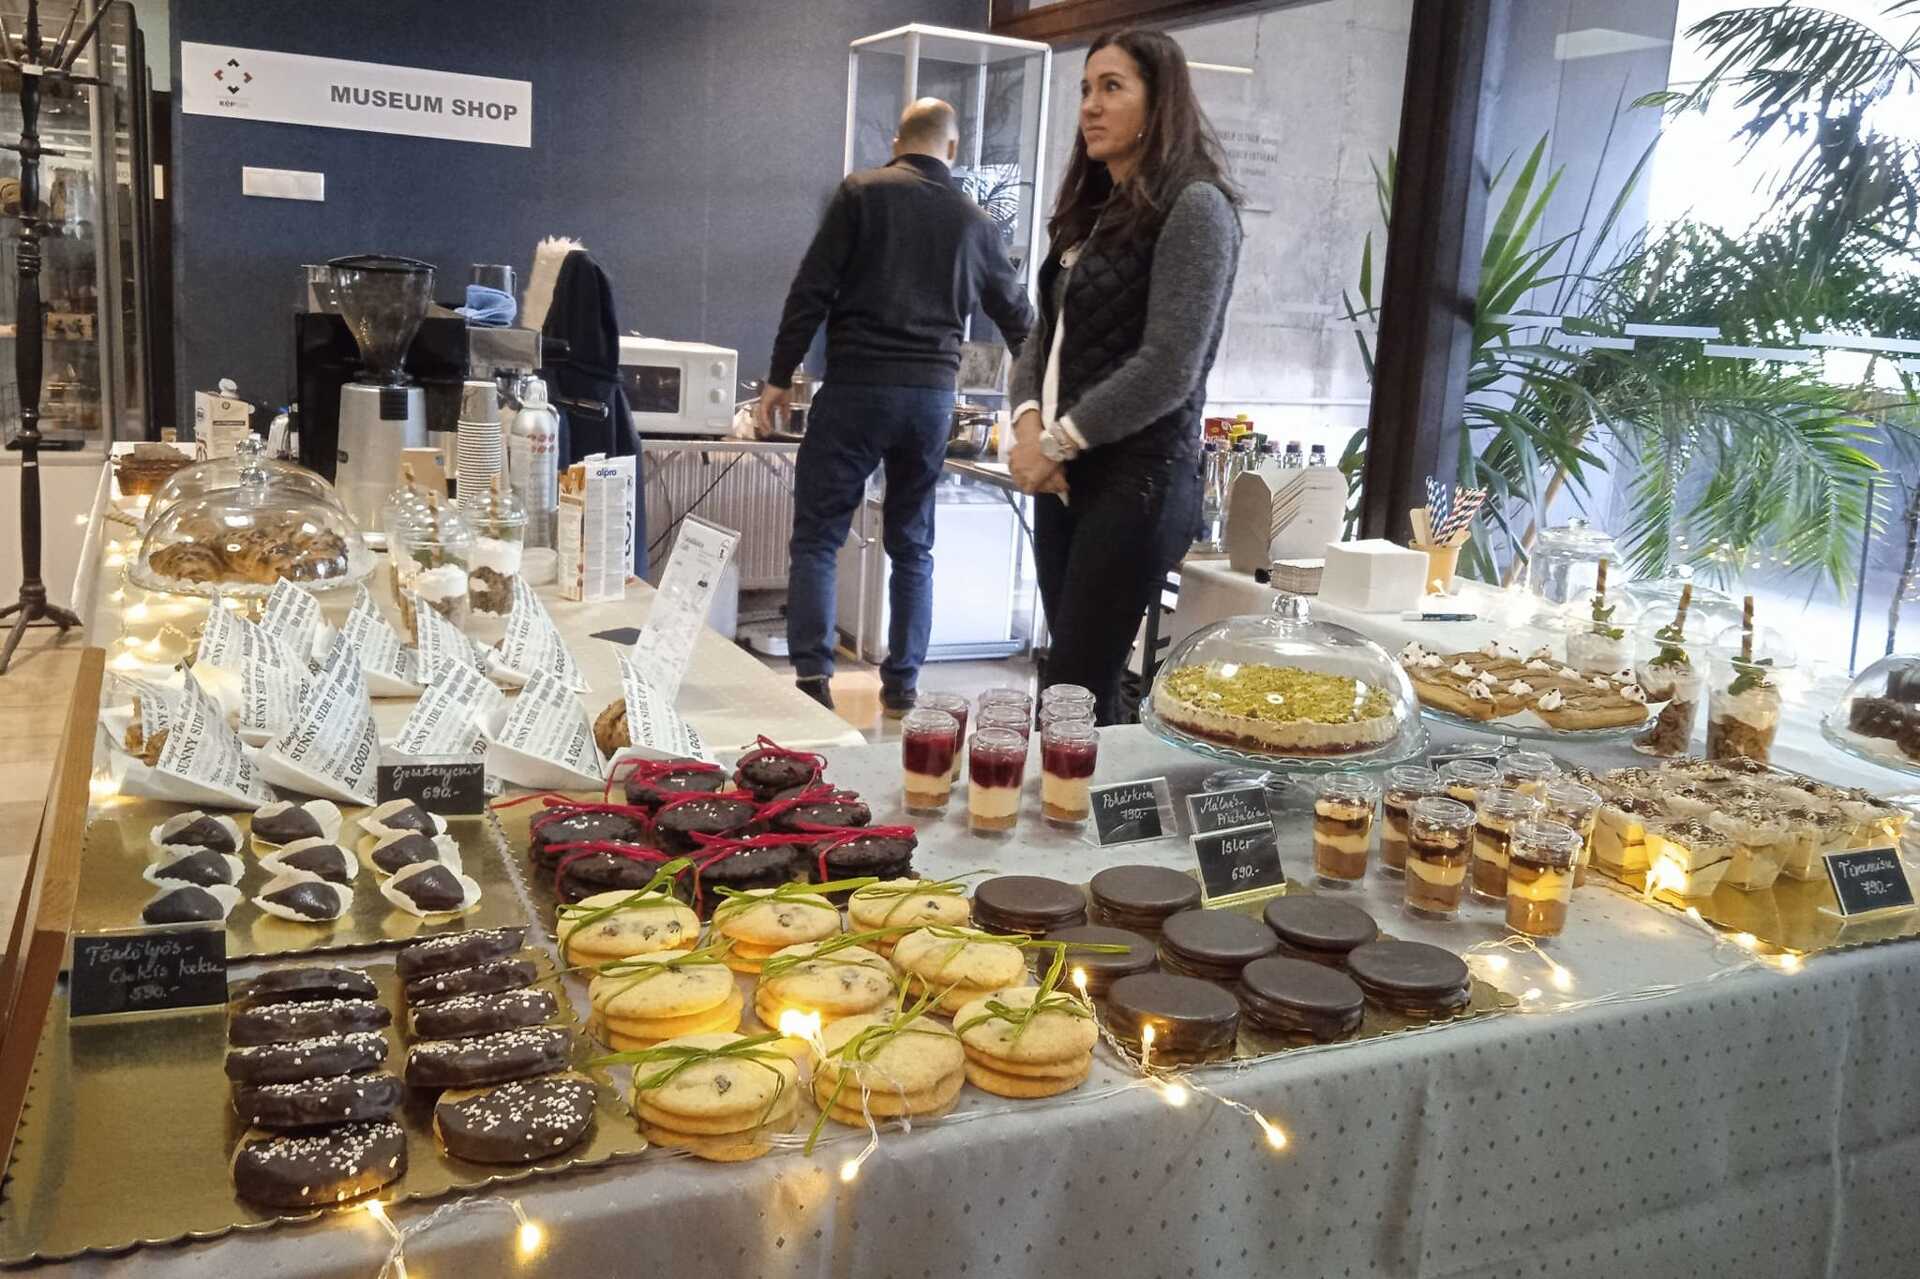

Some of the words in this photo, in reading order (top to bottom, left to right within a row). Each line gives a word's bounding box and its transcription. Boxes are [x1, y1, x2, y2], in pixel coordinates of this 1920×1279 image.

[331, 85, 443, 113] MUSEUM
[452, 99, 517, 120] SHOP
[596, 467, 617, 479] alpro
[255, 696, 267, 729] SUNNY
[425, 710, 441, 729] SIDE
[276, 724, 300, 753] Hunger
[290, 721, 320, 762] SUNNY
[315, 700, 333, 724] SIDE
[176, 736, 199, 776] SUNNY
[568, 736, 586, 757] GOOD
[238, 758, 252, 782] GOO
[344, 776, 357, 789] A
[351, 749, 370, 775] GOOD
[564, 757, 577, 767] A
[236, 782, 251, 795] A
[422, 786, 460, 800] 690.-
[1221, 838, 1255, 855] Isler
[1231, 867, 1260, 881] 690.-
[1860, 880, 1894, 895] 790.-
